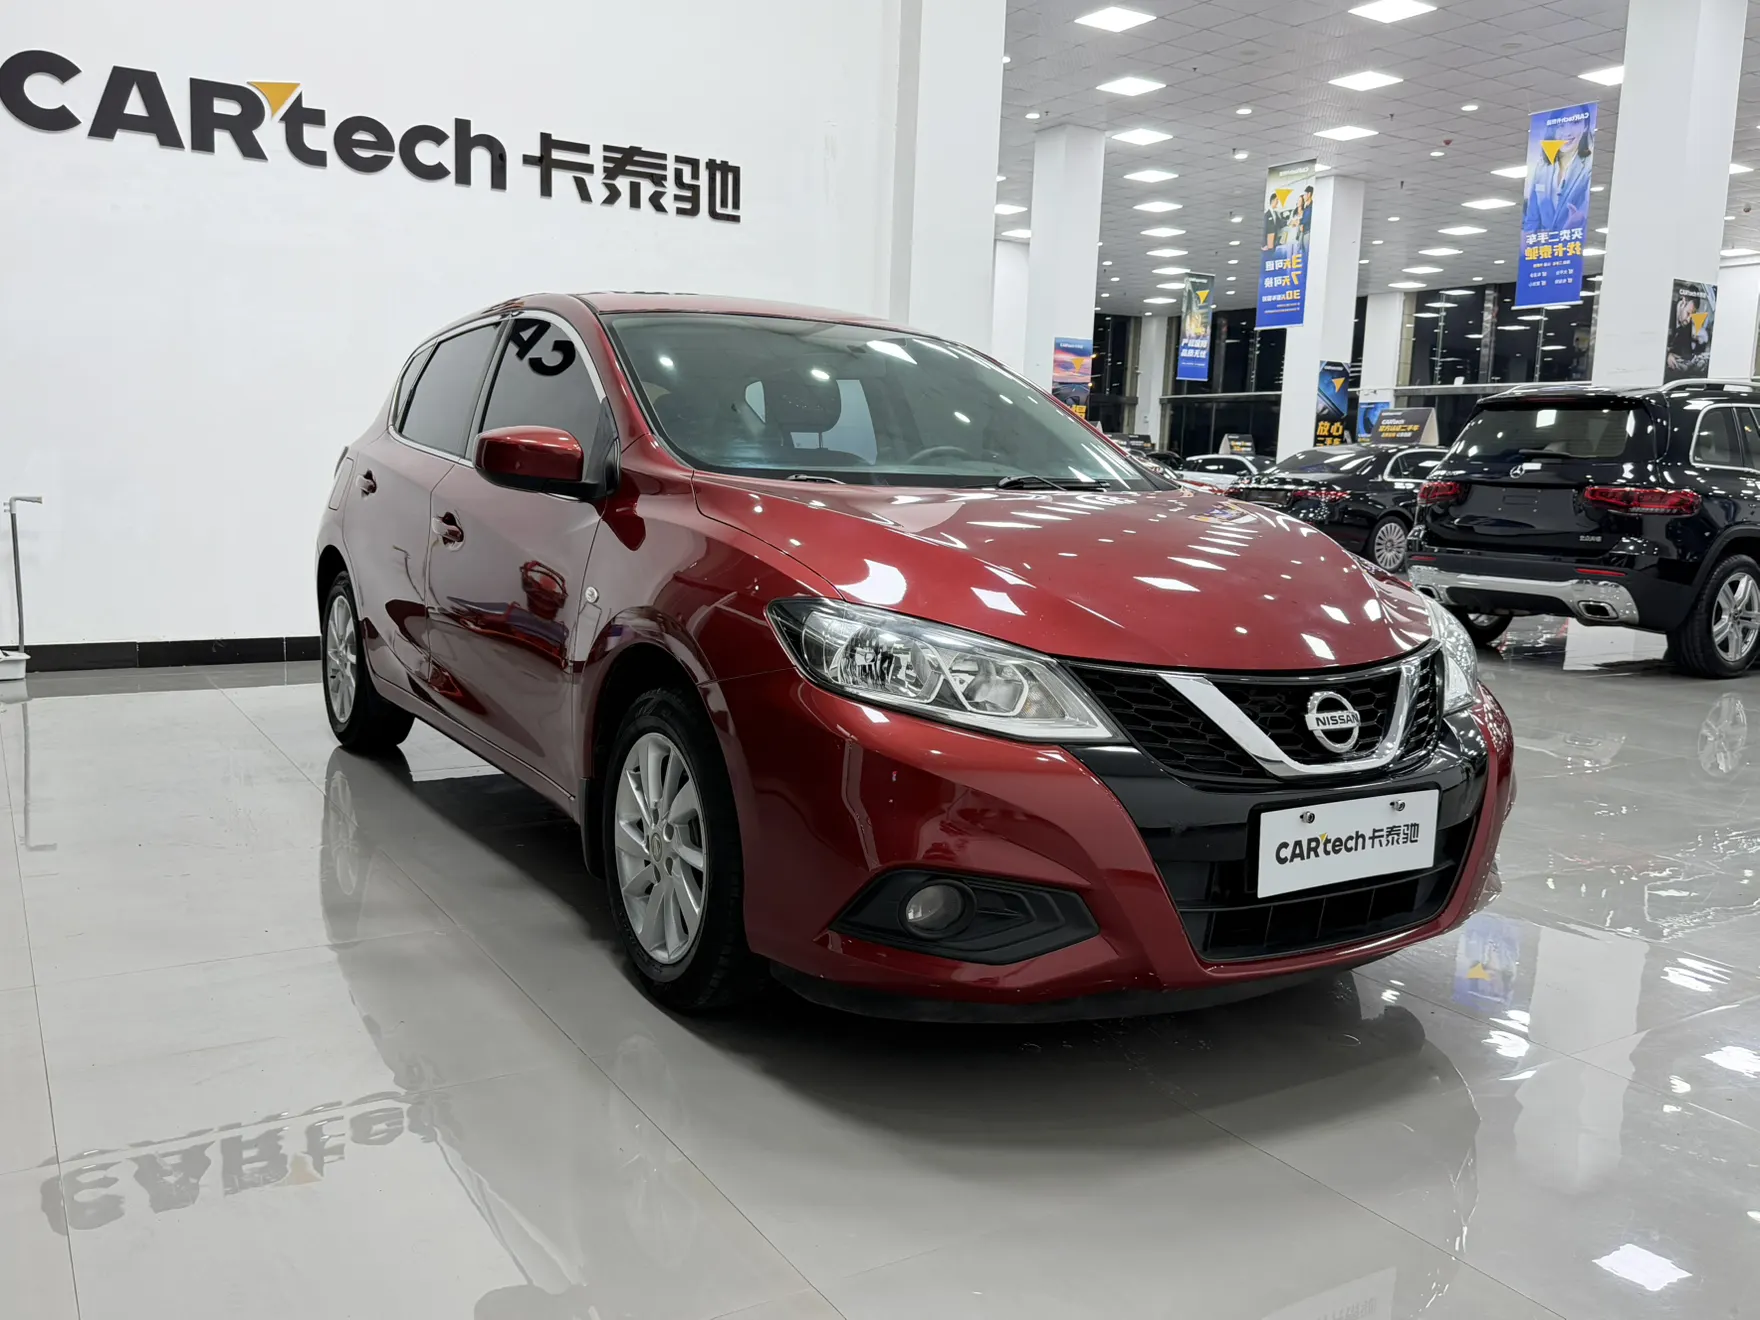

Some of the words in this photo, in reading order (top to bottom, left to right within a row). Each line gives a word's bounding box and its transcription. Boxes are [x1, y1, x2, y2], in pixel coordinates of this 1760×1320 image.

[0, 49, 507, 191] CARtech
[522, 131, 742, 223] 卡泰驰
[1316, 420, 1344, 436] 放心
[1315, 711, 1360, 727] NISSAN
[1275, 830, 1366, 865] CARtech
[1368, 822, 1420, 849] 卡泰驰
